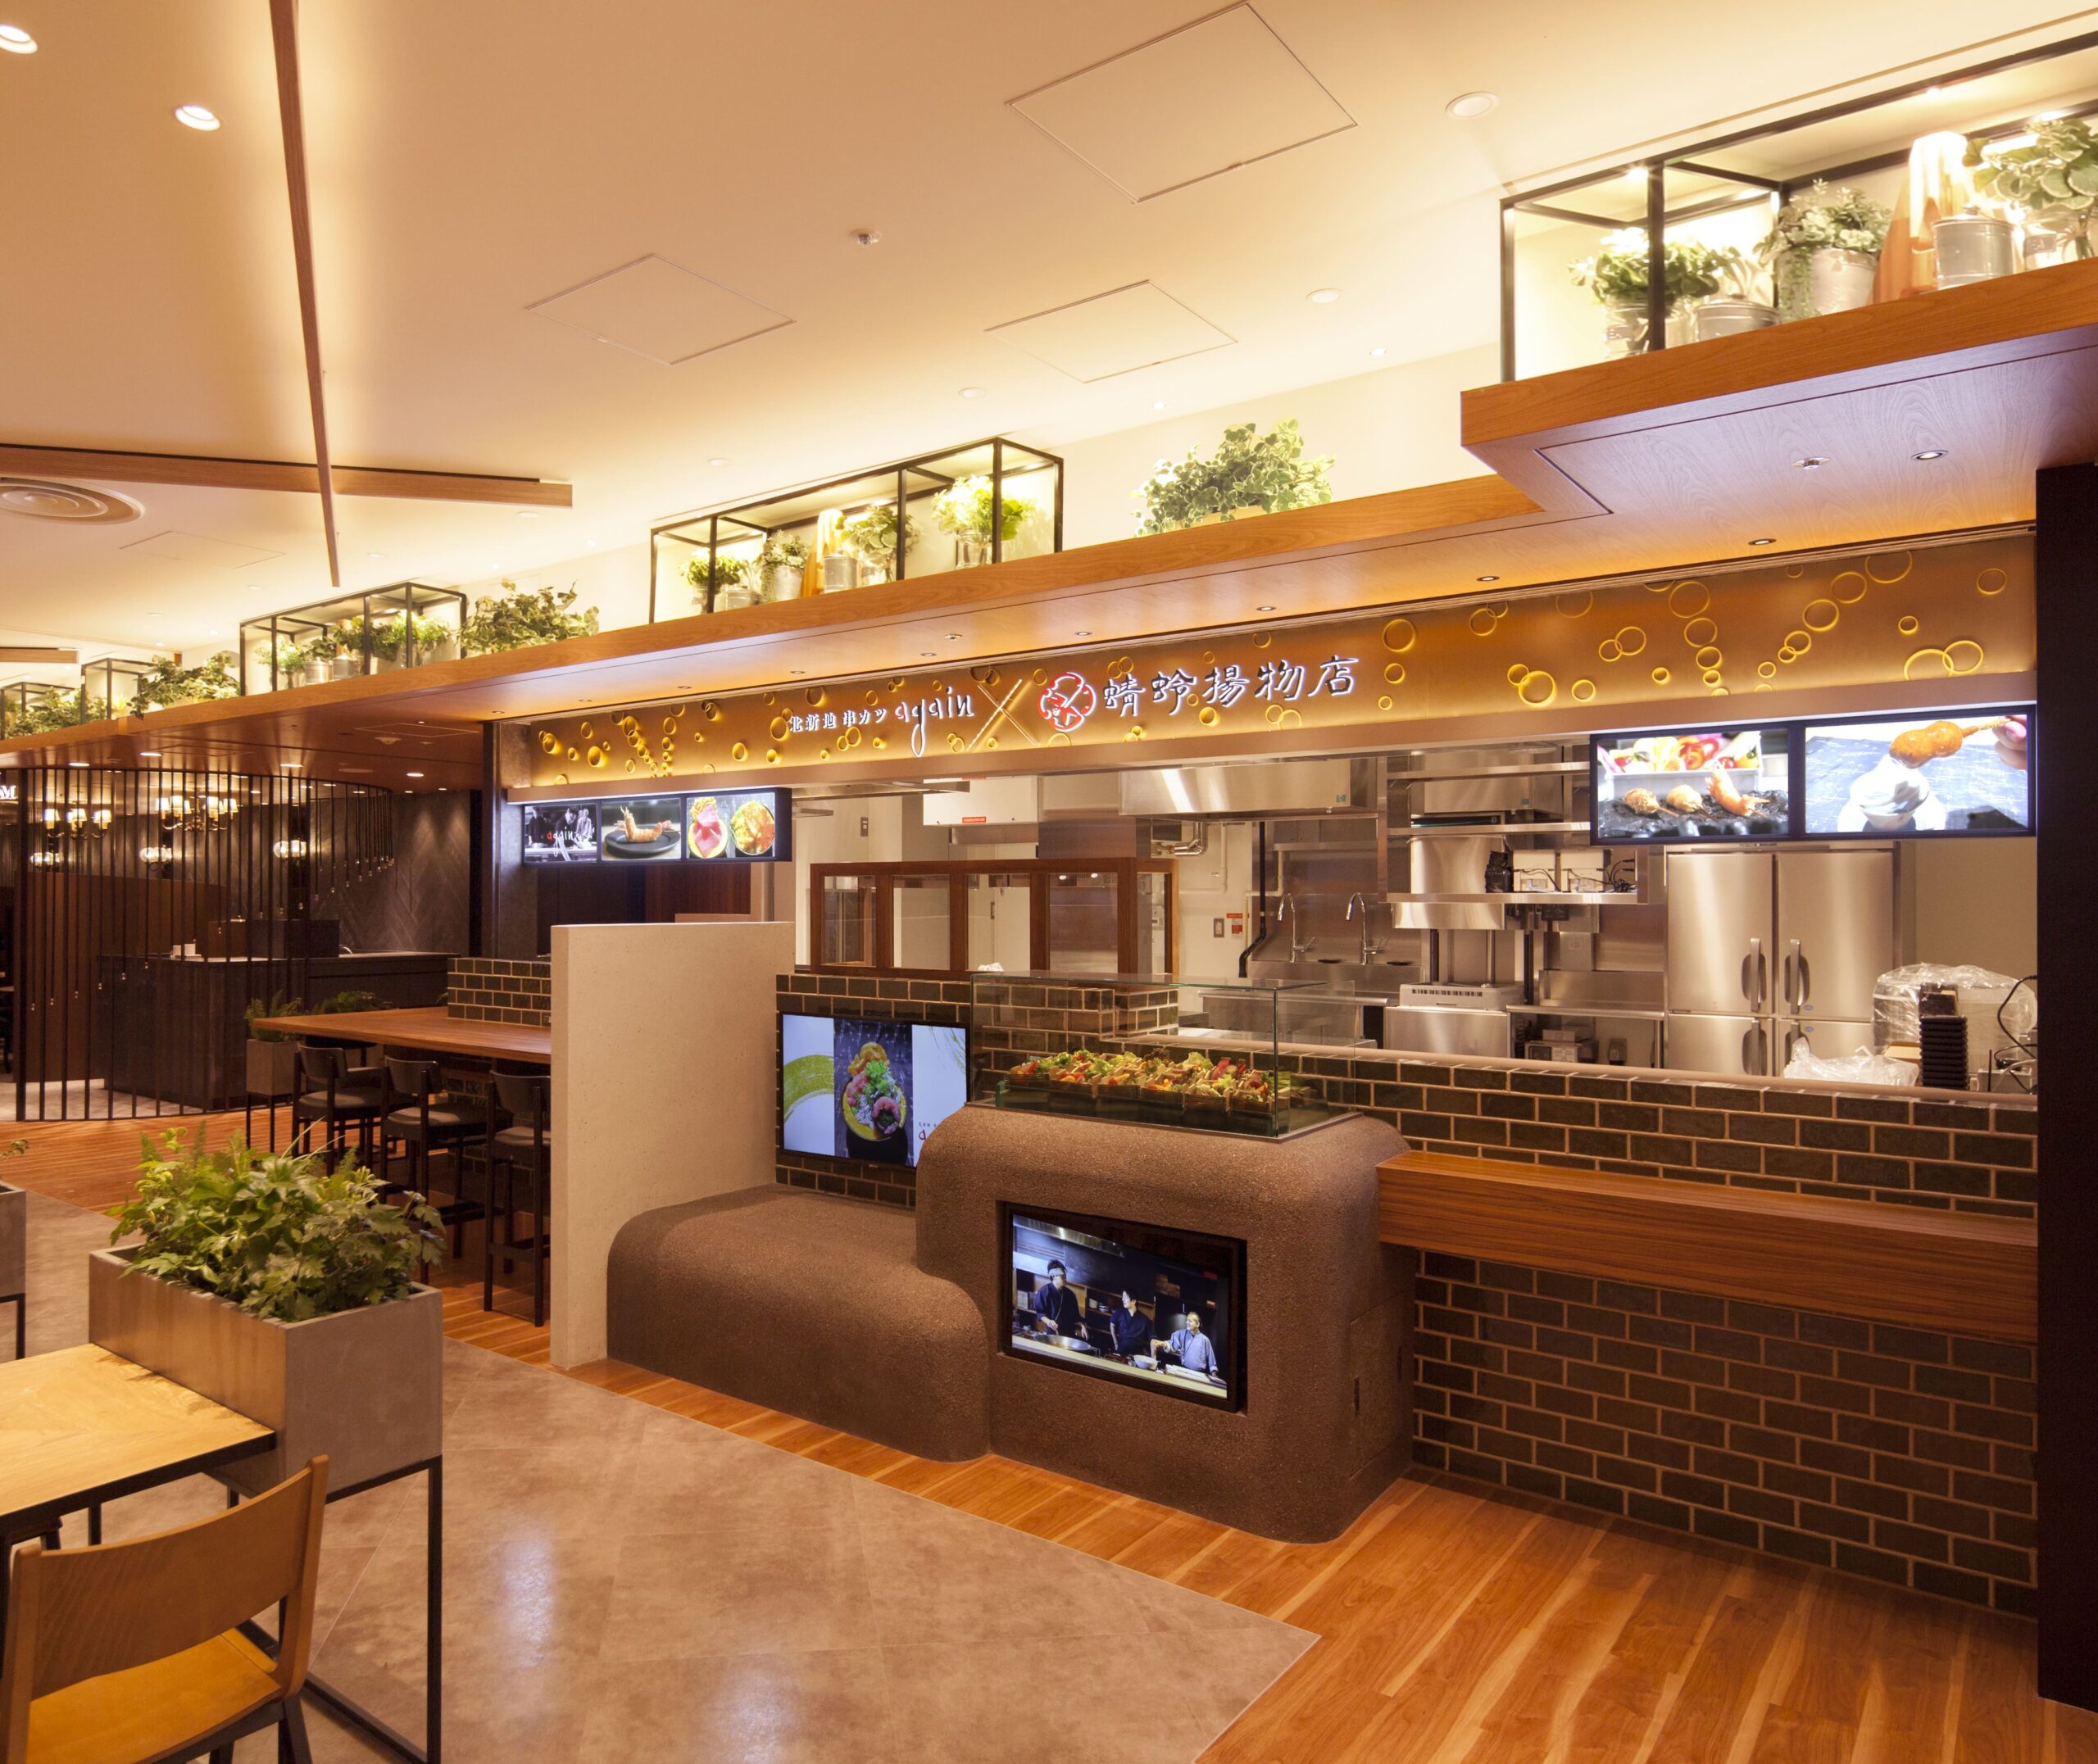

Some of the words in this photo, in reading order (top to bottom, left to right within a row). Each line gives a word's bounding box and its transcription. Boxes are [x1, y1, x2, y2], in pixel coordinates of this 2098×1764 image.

[1103, 655, 1360, 718] 蜻蛉揚物店
[789, 713, 837, 732] 北新地
[842, 708, 887, 728] 串カツ
[894, 686, 975, 758] again
